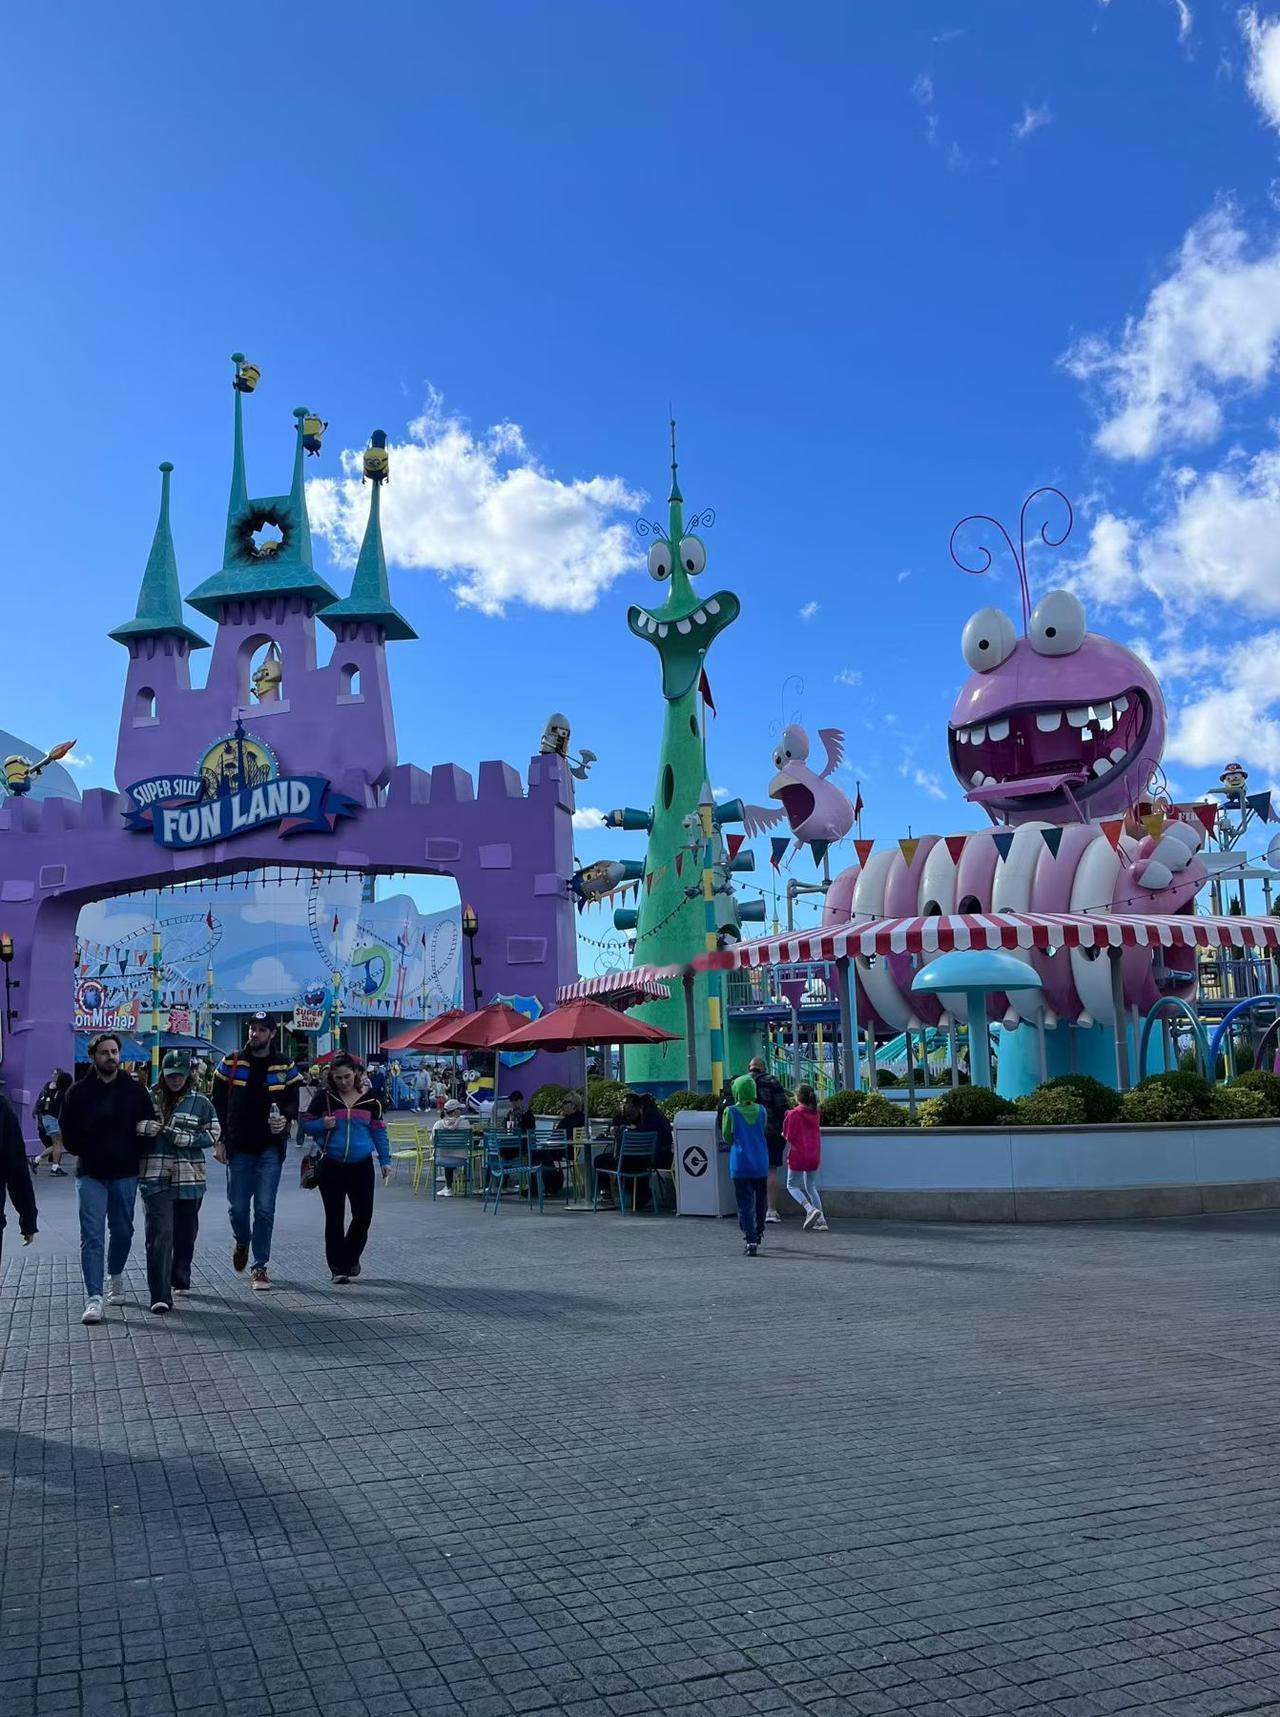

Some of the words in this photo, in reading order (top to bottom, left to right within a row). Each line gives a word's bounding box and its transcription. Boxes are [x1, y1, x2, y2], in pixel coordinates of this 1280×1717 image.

[133, 780, 171, 807] SUPER
[174, 778, 200, 796] SILLY
[163, 802, 222, 842] FUN
[231, 781, 311, 831] LAND
[296, 1008, 322, 1017] SUPER
[297, 1020, 319, 1028] STUFF
